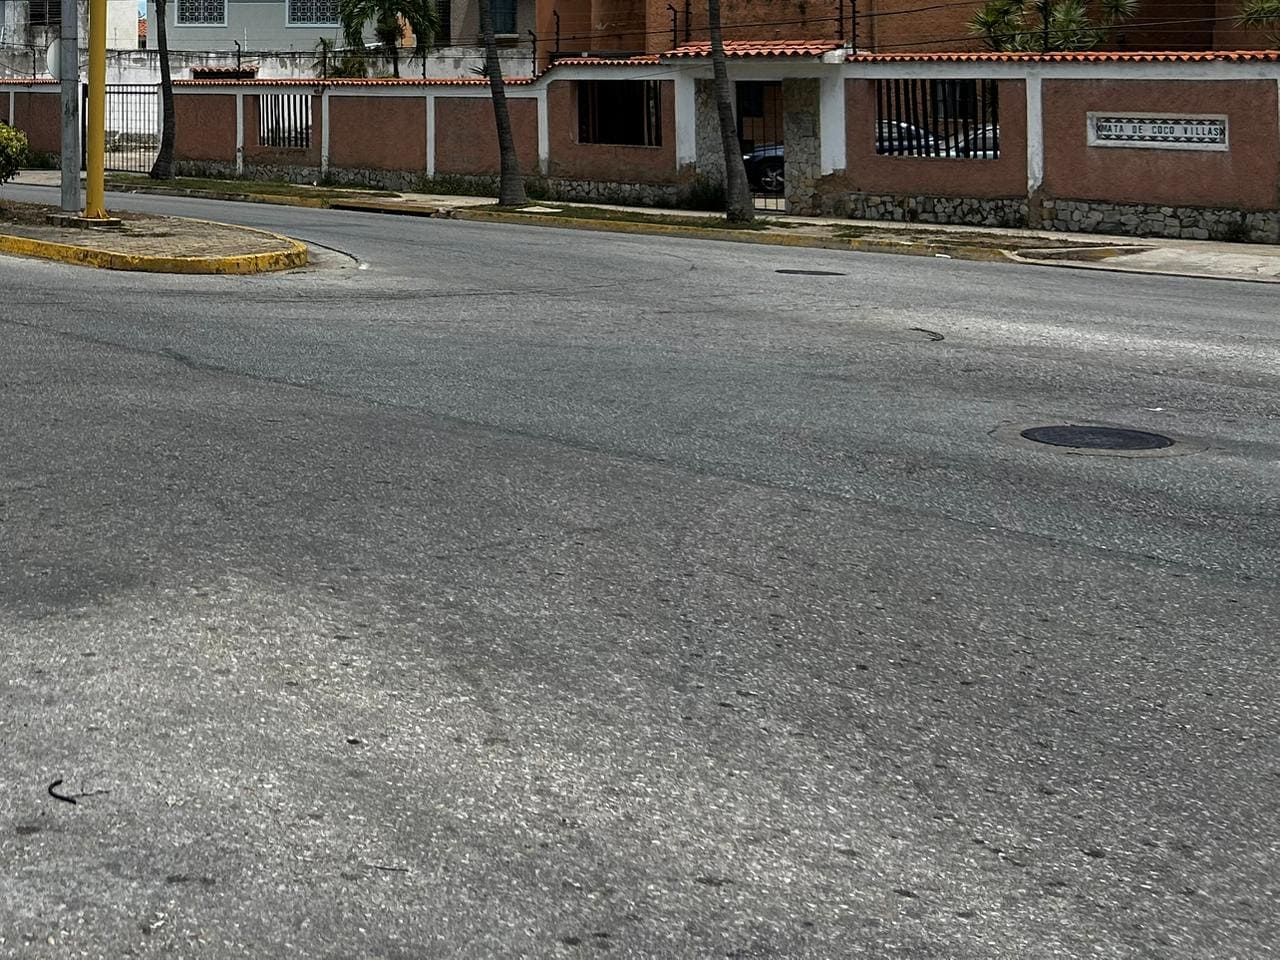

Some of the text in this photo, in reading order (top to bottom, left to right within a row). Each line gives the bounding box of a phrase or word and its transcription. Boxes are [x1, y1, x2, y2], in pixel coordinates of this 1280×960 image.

[1100, 123, 1219, 136] MATA DE COCO VILLAS
